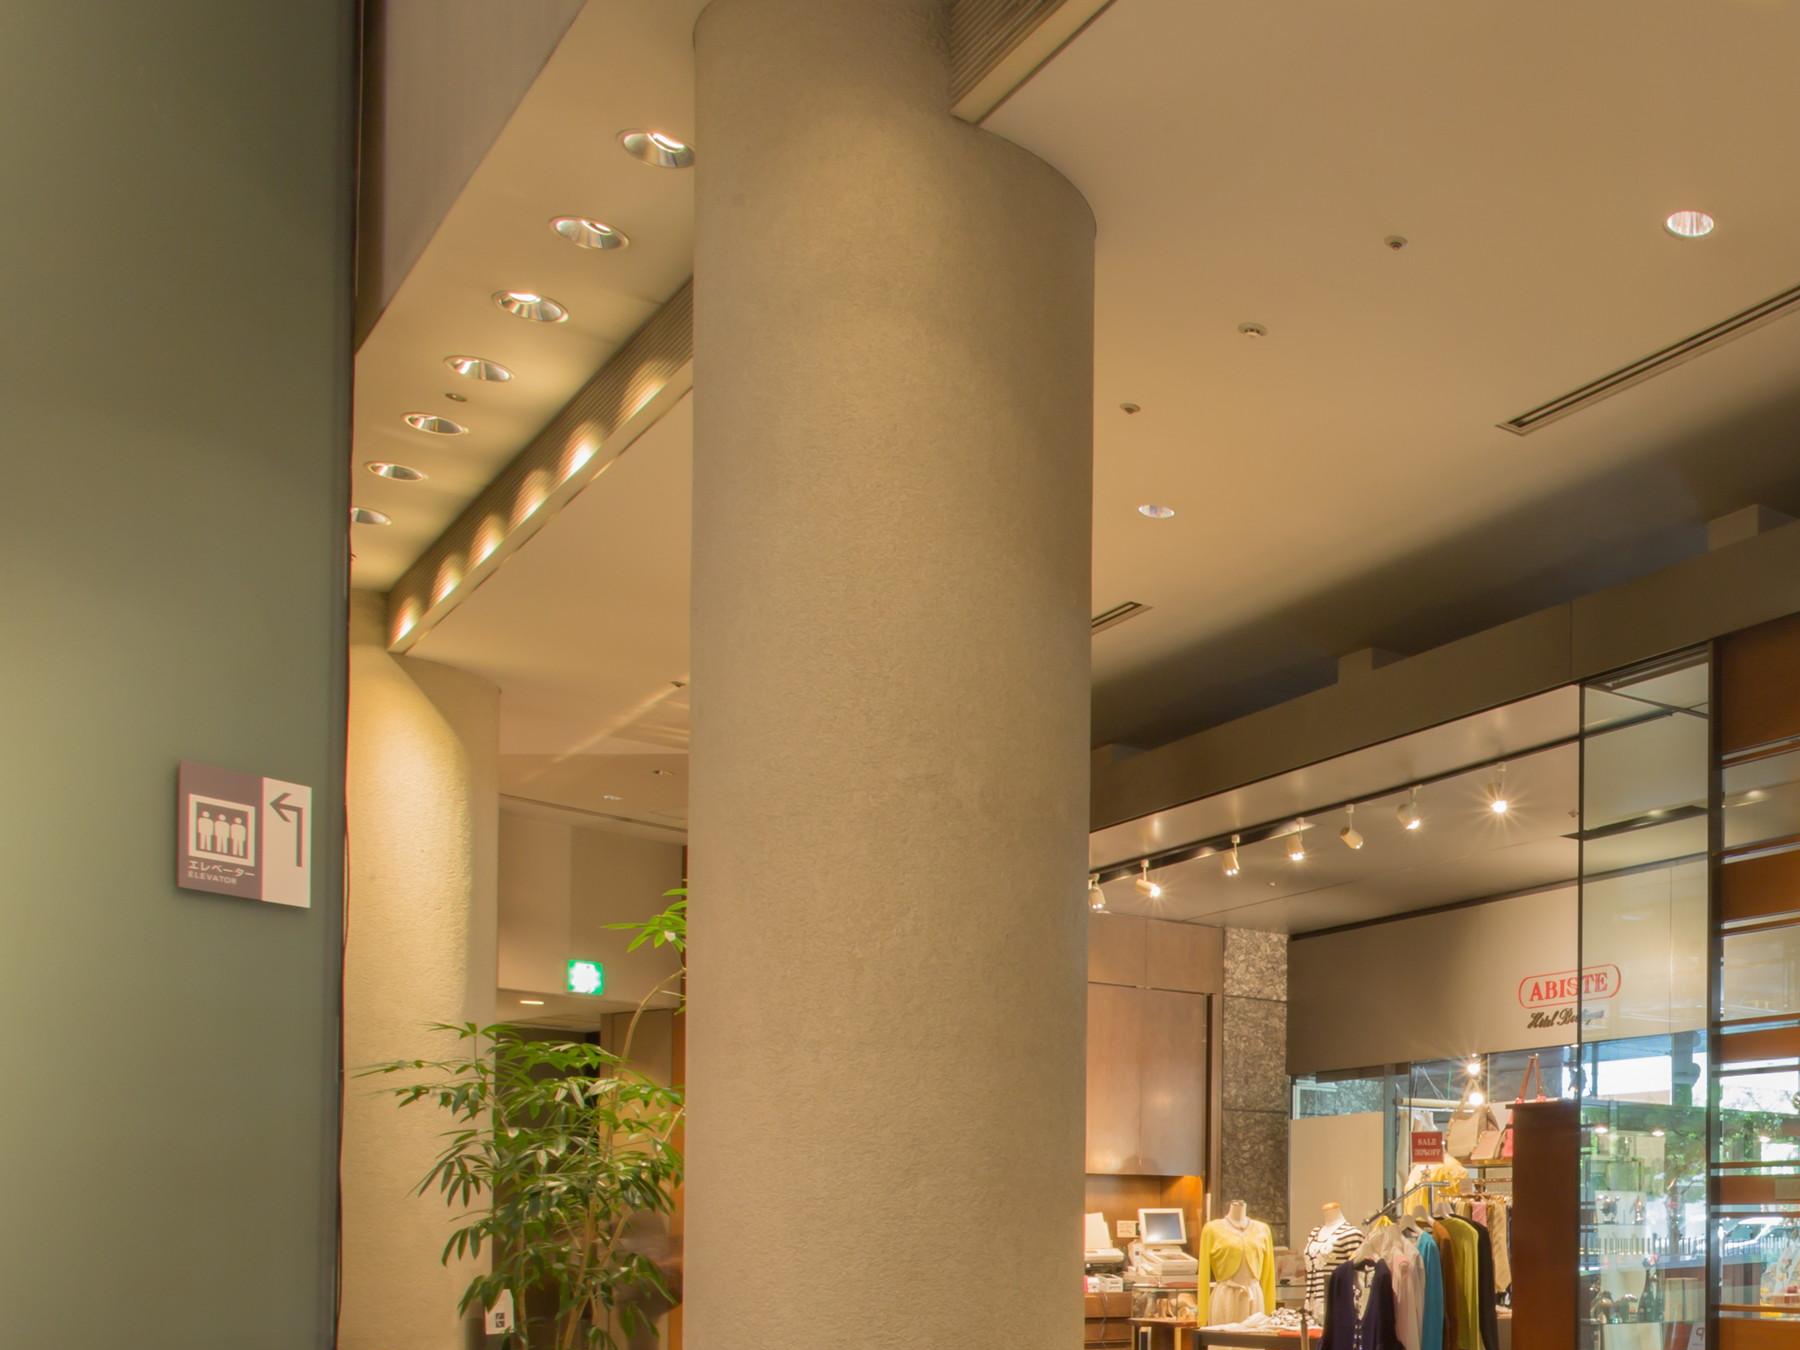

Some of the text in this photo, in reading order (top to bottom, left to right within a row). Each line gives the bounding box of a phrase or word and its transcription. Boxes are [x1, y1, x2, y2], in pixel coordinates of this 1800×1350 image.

[188, 860, 255, 877] エレベーター
[188, 870, 237, 885] ELEVATOR
[1529, 972, 1608, 1001] ABISTE
[1527, 1010, 1559, 1029] Hotel
[1417, 1138, 1437, 1146] SALE
